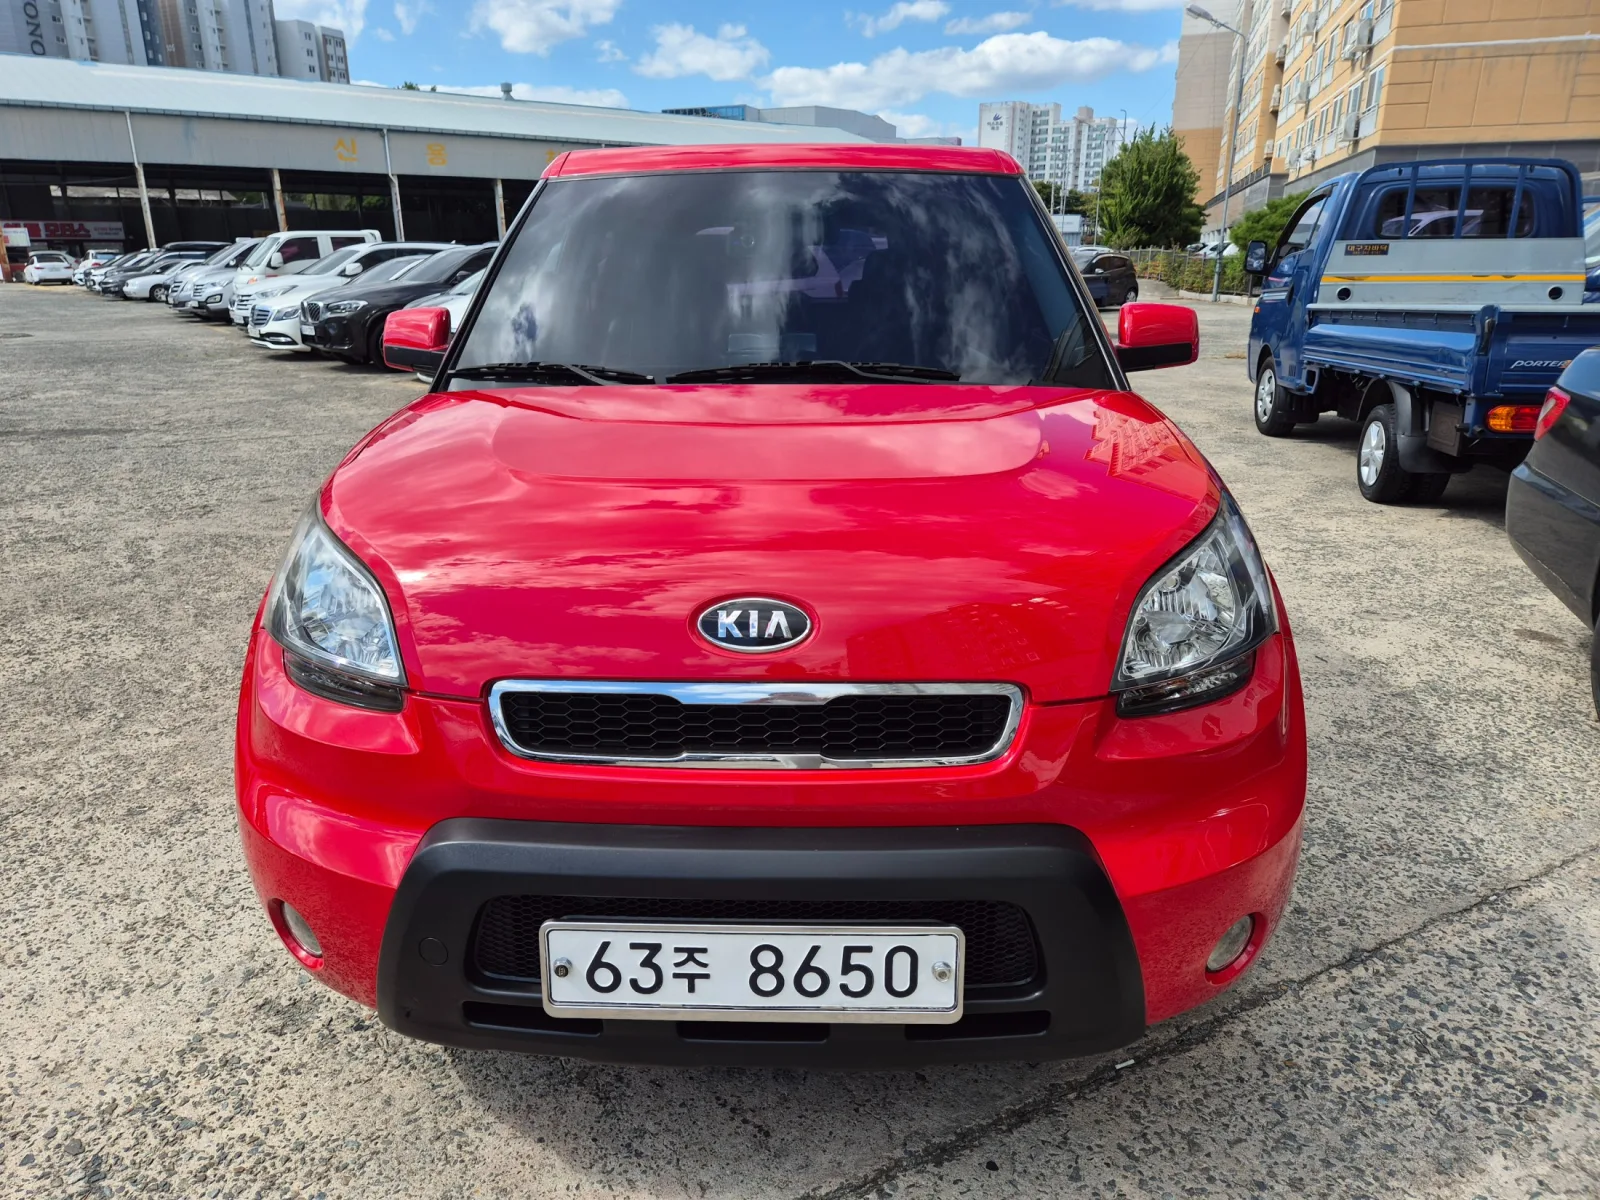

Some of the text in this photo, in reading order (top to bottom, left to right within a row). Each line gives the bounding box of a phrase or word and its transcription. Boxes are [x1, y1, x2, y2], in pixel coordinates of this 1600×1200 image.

[333, 137, 448, 166] 신 용
[1509, 359, 1566, 369] PORTER
[716, 609, 793, 639] KIA
[585, 940, 919, 998] 63주 8650
